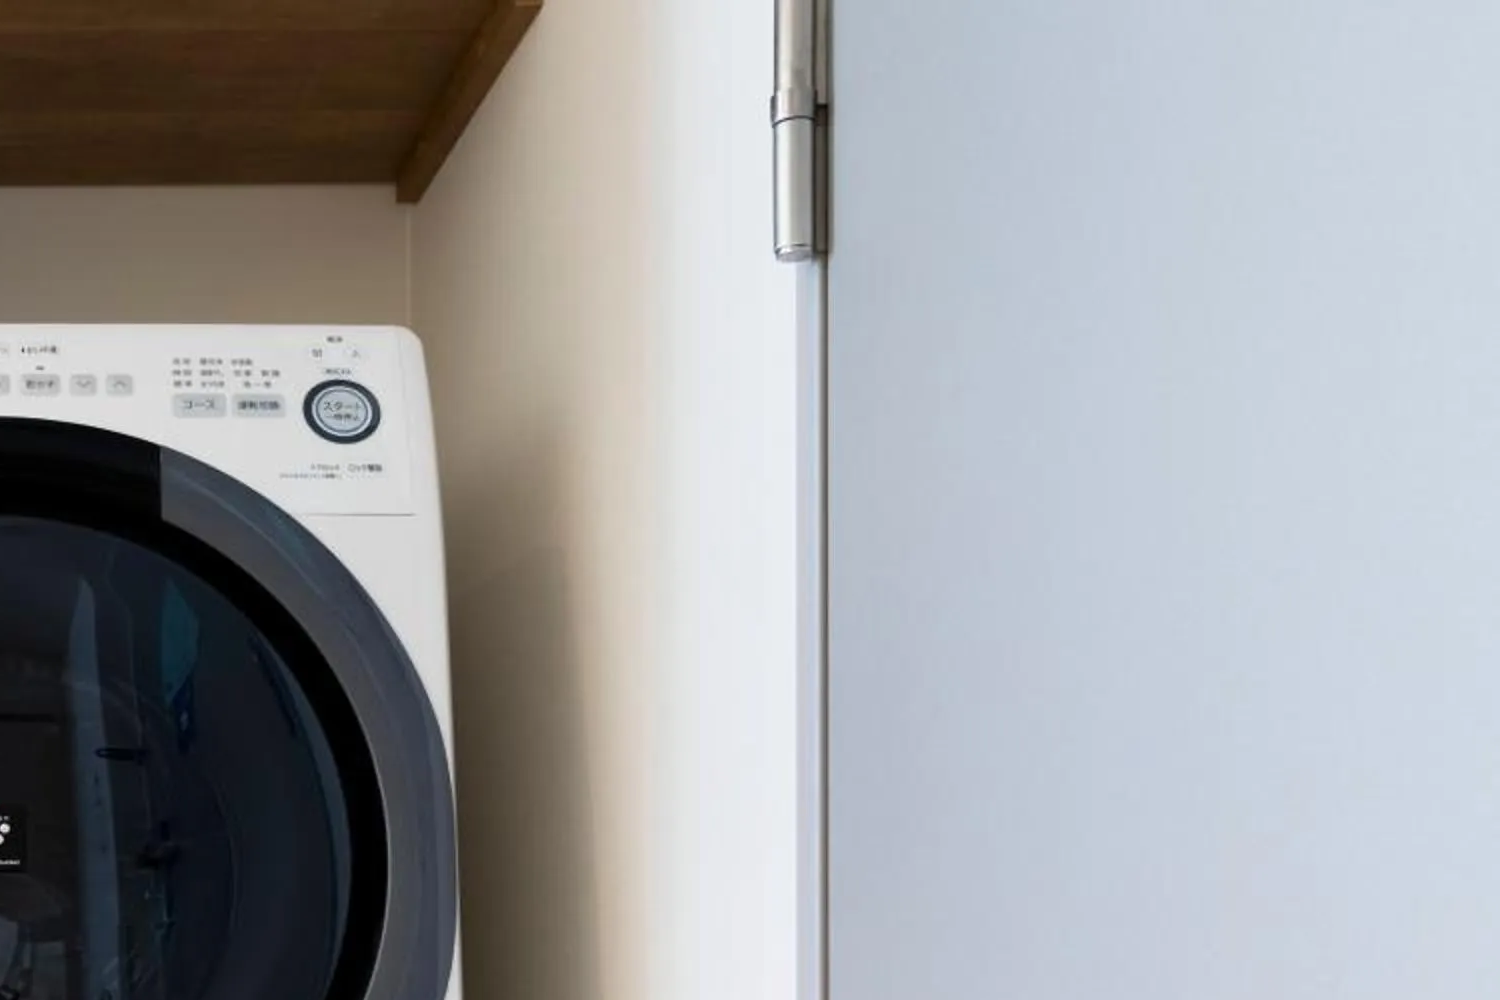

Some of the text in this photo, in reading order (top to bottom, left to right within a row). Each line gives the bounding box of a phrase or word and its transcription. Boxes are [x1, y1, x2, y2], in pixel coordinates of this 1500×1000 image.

[183, 400, 215, 410] コース
[323, 401, 361, 412] スタート
